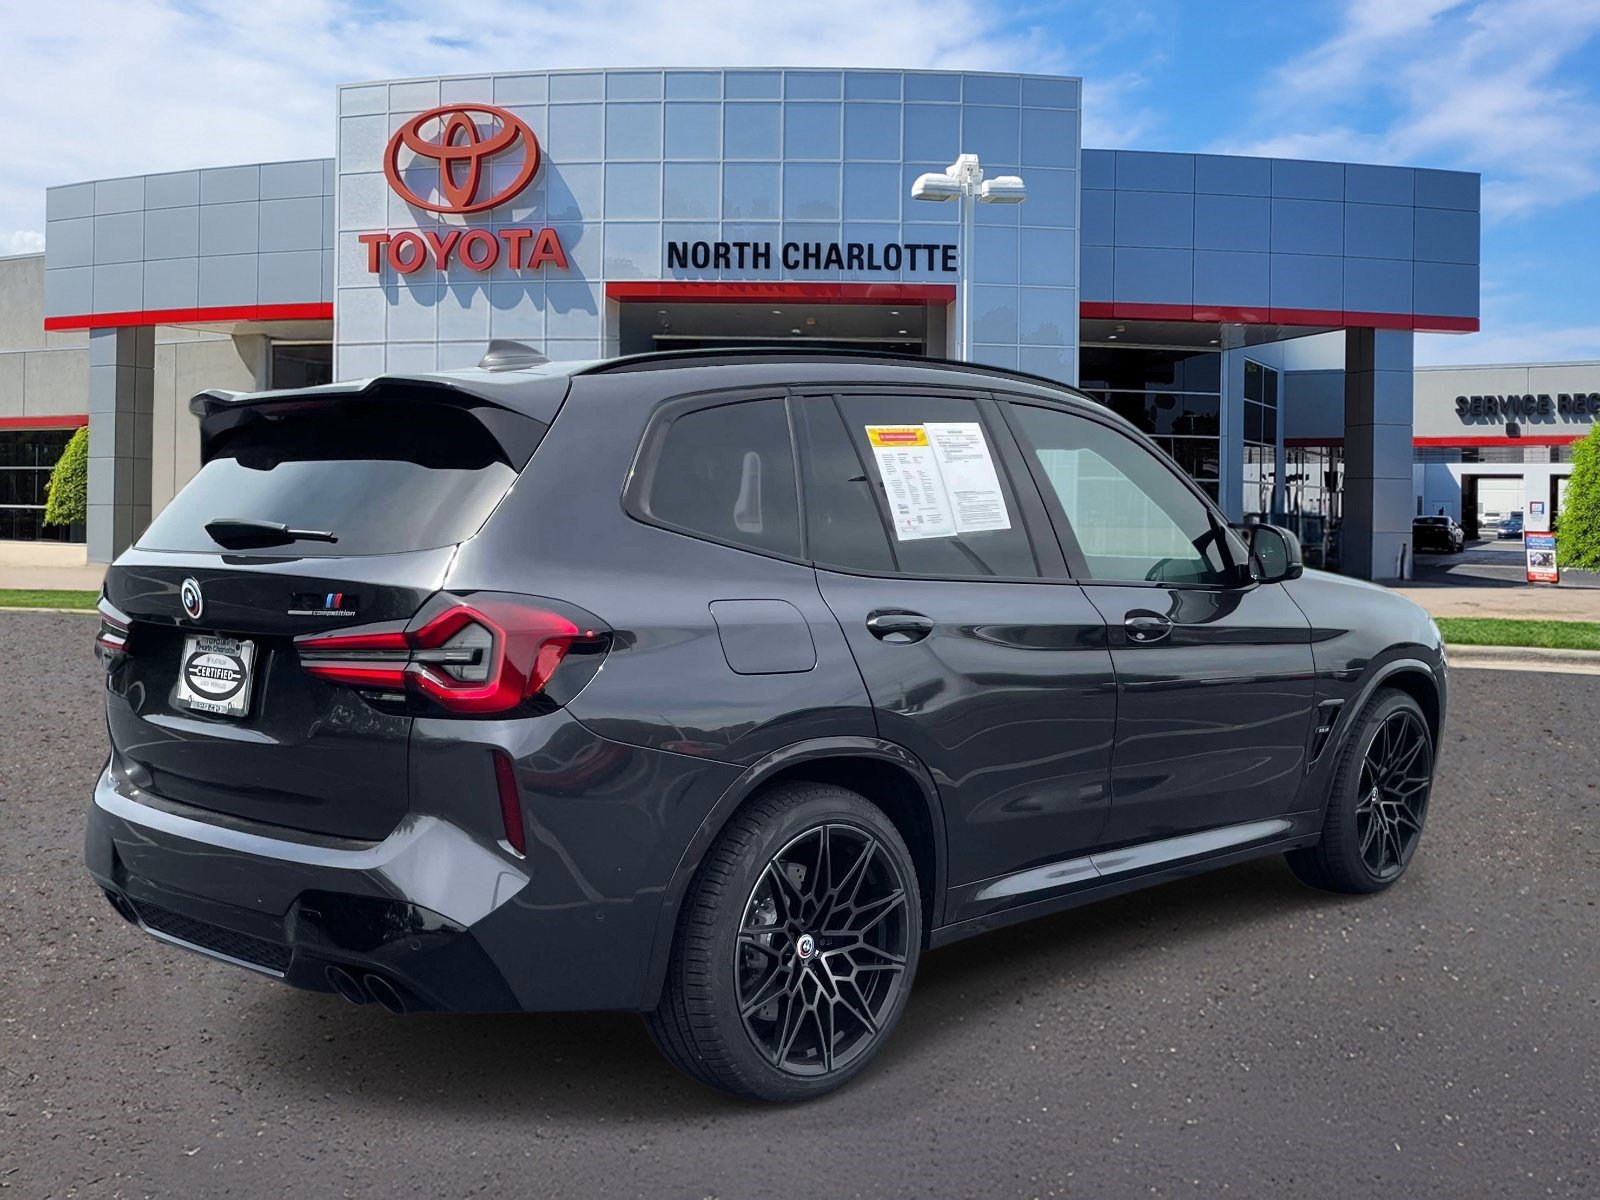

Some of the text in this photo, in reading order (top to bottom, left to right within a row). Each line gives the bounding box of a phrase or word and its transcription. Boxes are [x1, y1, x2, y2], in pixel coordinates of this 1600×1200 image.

[358, 227, 569, 275] TOYOTA
[667, 241, 958, 273] NORTH CHARLOTTE
[1455, 394, 1551, 416] SERVICE
[196, 666, 233, 680] CERTIFIED
